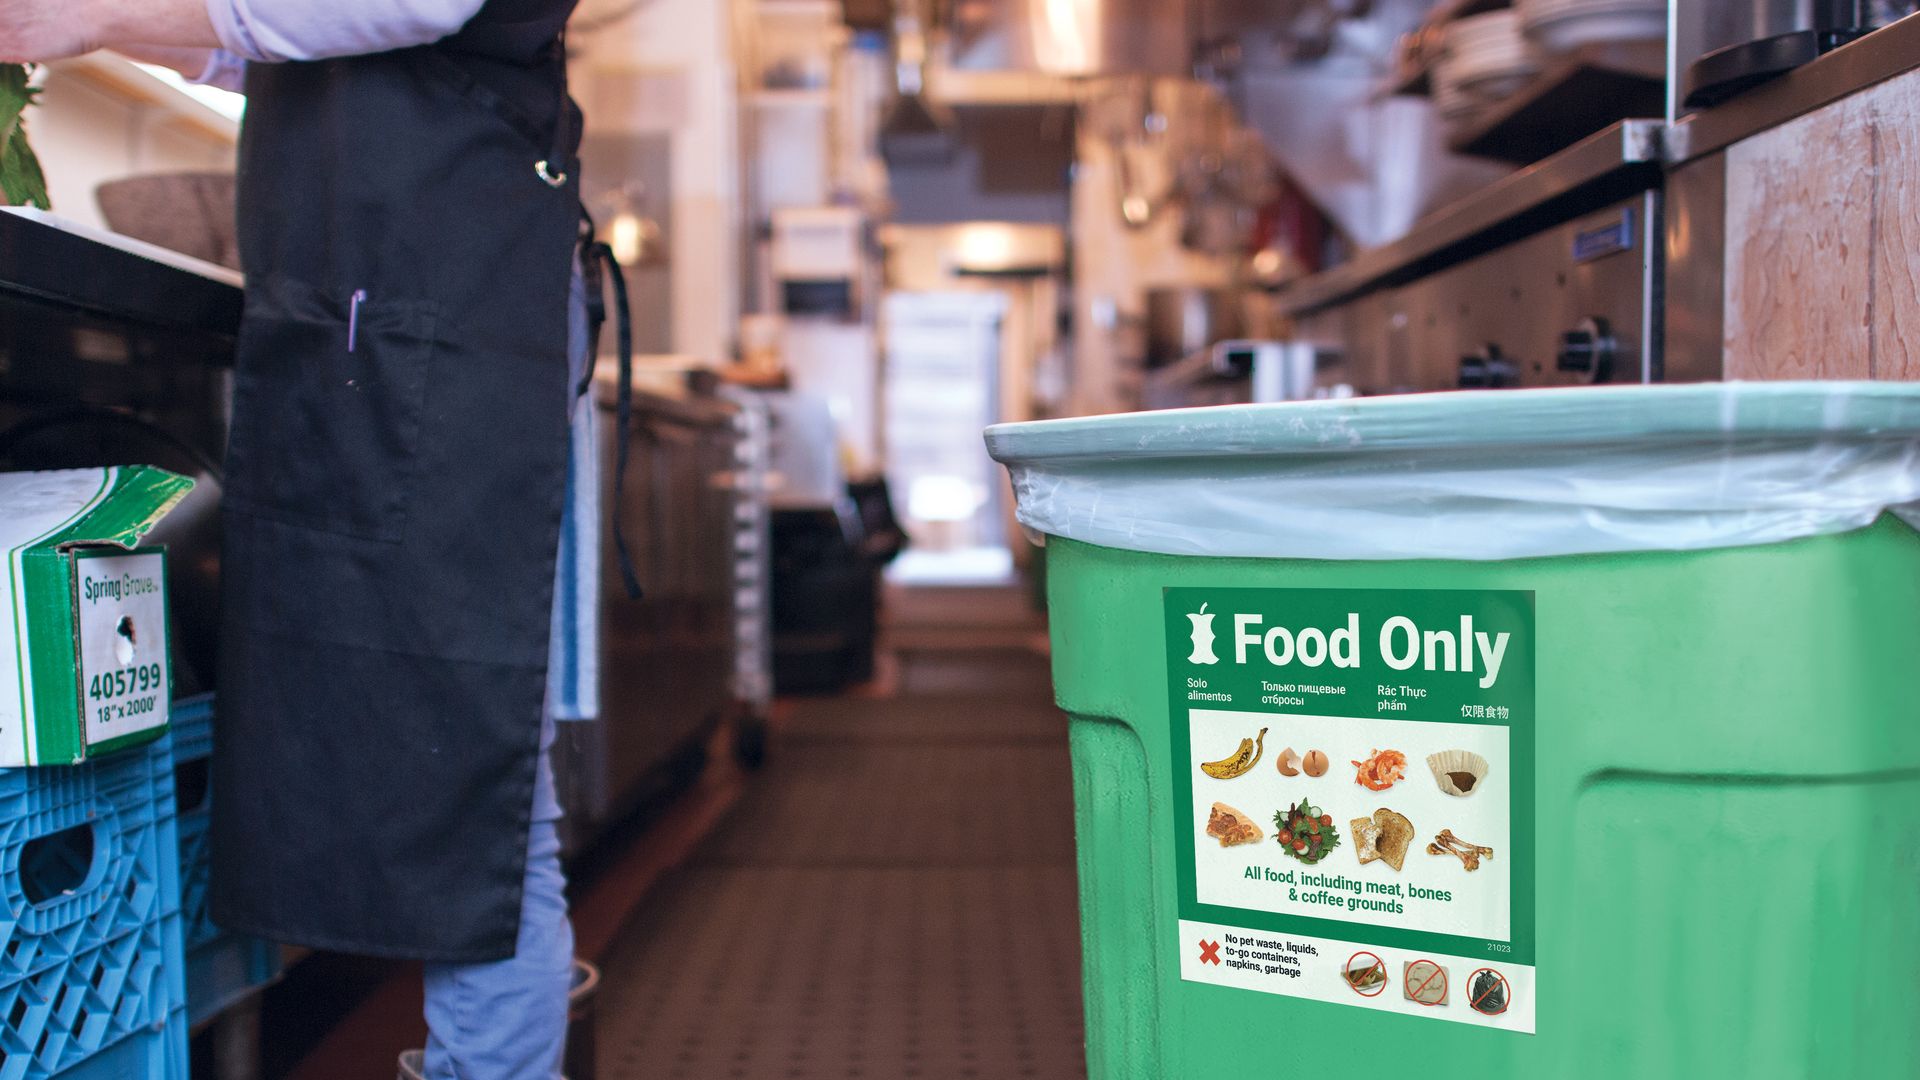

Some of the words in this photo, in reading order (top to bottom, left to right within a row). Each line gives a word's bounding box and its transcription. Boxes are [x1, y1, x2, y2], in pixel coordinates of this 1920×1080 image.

[1234, 612, 1361, 669] Food
[1379, 614, 1511, 690] Only
[89, 663, 161, 701] 405799
[1187, 677, 1208, 689] Solo
[1261, 680, 1296, 693] Только
[1298, 684, 1346, 696] пищевые
[1187, 690, 1232, 703] alimentos
[1377, 684, 1397, 696] Rác
[1399, 685, 1427, 699] Thực
[1261, 694, 1305, 707] отбросы
[1460, 704, 1510, 720] 仅限食物
[1244, 865, 1261, 880] All
[1265, 867, 1298, 887] food,
[1301, 872, 1362, 894] including
[1366, 880, 1405, 899] meat,
[1408, 883, 1452, 902] bones
[1288, 887, 1298, 901] &
[1301, 890, 1344, 907] coffee
[1347, 897, 1404, 914] grounds
[1225, 933, 1238, 943] No
[1239, 937, 1254, 946] pet
[1256, 939, 1285, 952] waste,
[1286, 941, 1319, 957] liquids,
[1487, 942, 1511, 953] 21023
[1225, 946, 1250, 959] to-go
[1251, 950, 1301, 966] containers,
[1226, 959, 1263, 973] napkins,
[1264, 964, 1301, 978] garbage
